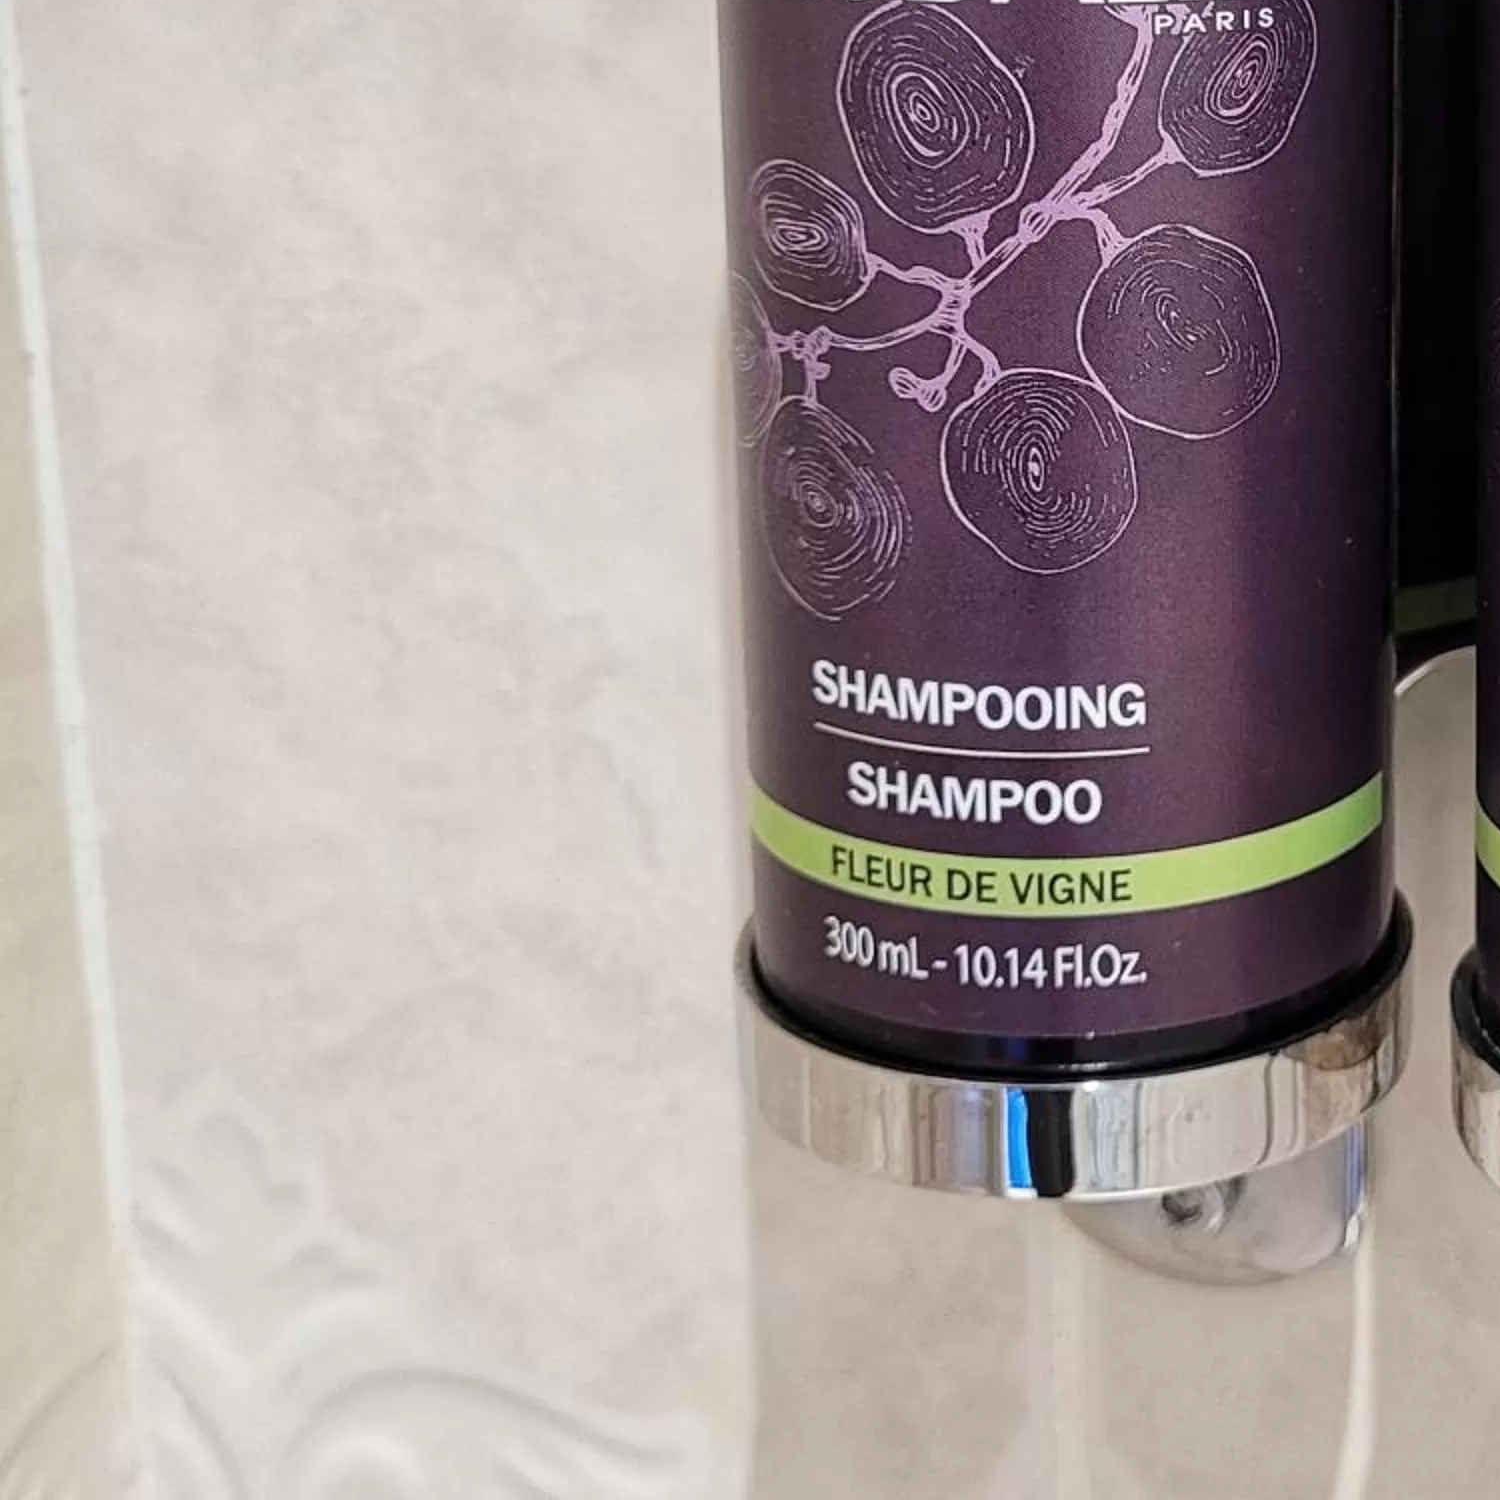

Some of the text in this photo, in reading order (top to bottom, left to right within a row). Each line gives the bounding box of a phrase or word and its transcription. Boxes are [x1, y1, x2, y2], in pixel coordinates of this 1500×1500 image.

[1154, 7, 1275, 35] PARIS
[812, 659, 1147, 731] SHAMPOOING
[847, 761, 1103, 825] SHAMPOO
[831, 844, 1134, 905] FLEUR DE VIGNE
[823, 914, 875, 968] 300
[878, 934, 930, 980] mL
[953, 944, 1048, 990] 10.14
